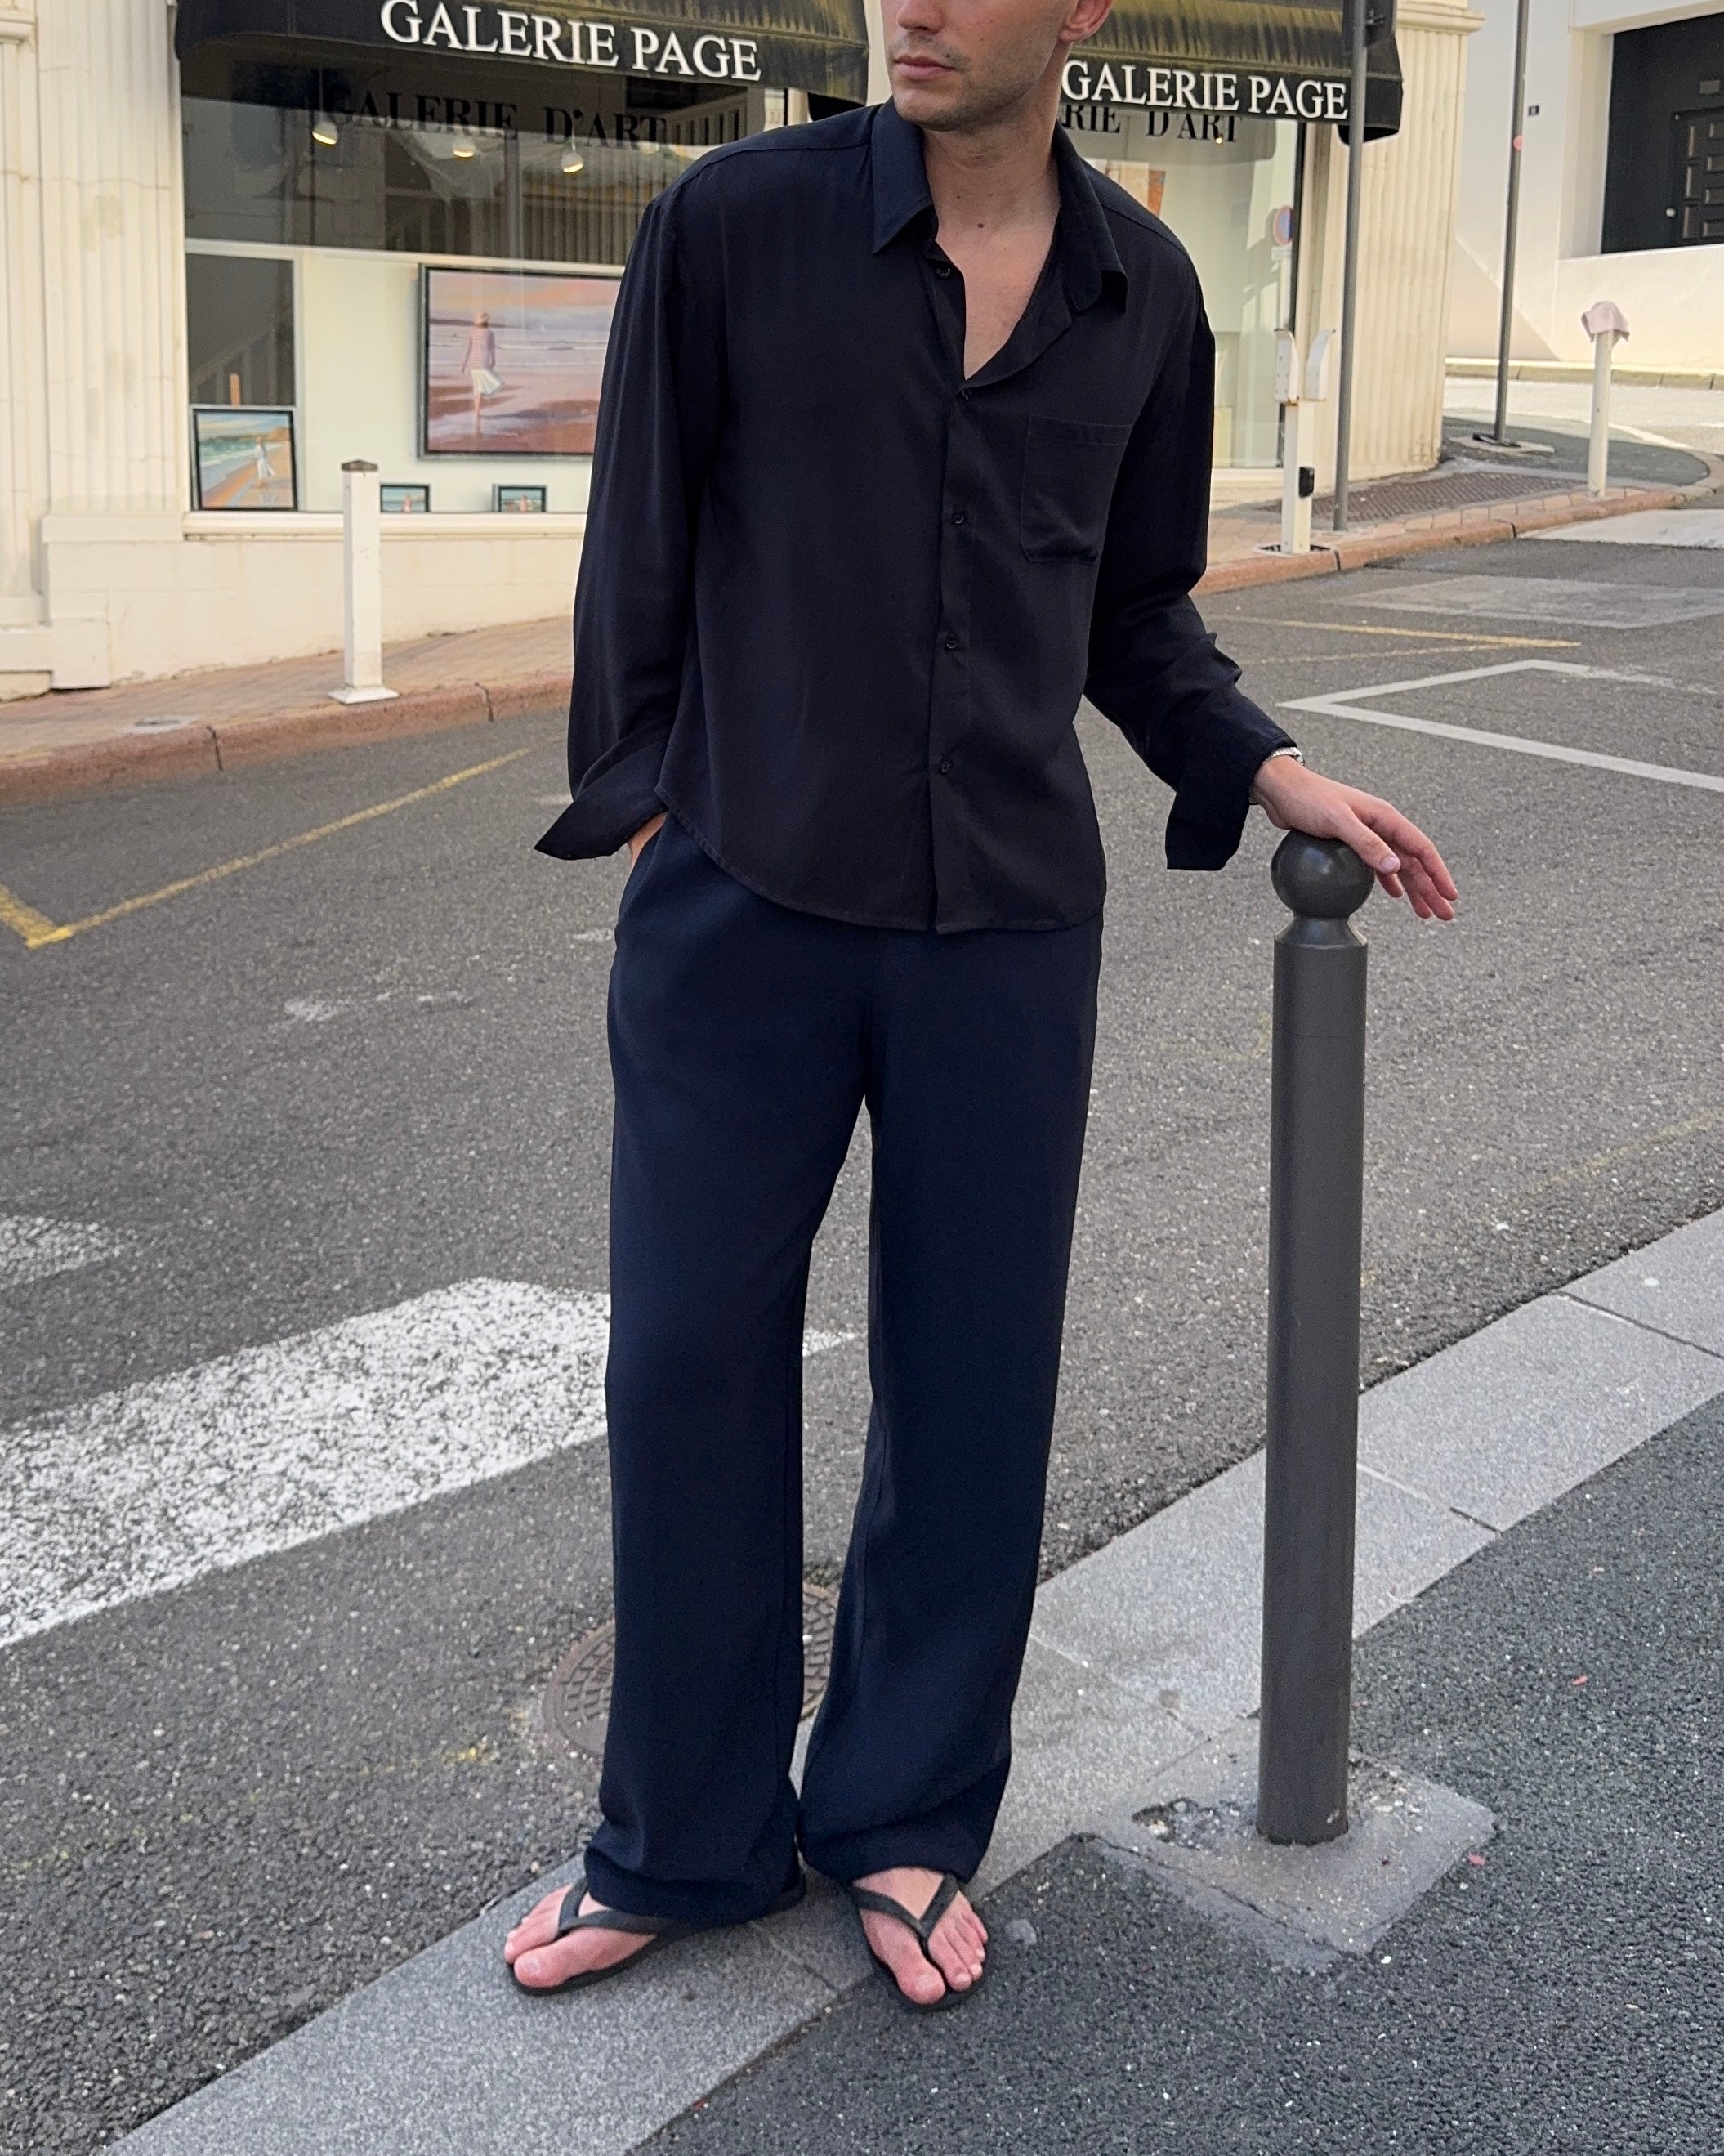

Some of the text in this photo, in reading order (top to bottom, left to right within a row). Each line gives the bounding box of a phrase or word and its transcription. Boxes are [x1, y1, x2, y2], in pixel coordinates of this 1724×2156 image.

[381, 0, 762, 80] GALERIE PAGE
[329, 89, 668, 150] GALERIE D'ART
[1062, 60, 1348, 120] GALERIE PAGE
[1146, 110, 1242, 142] DART
